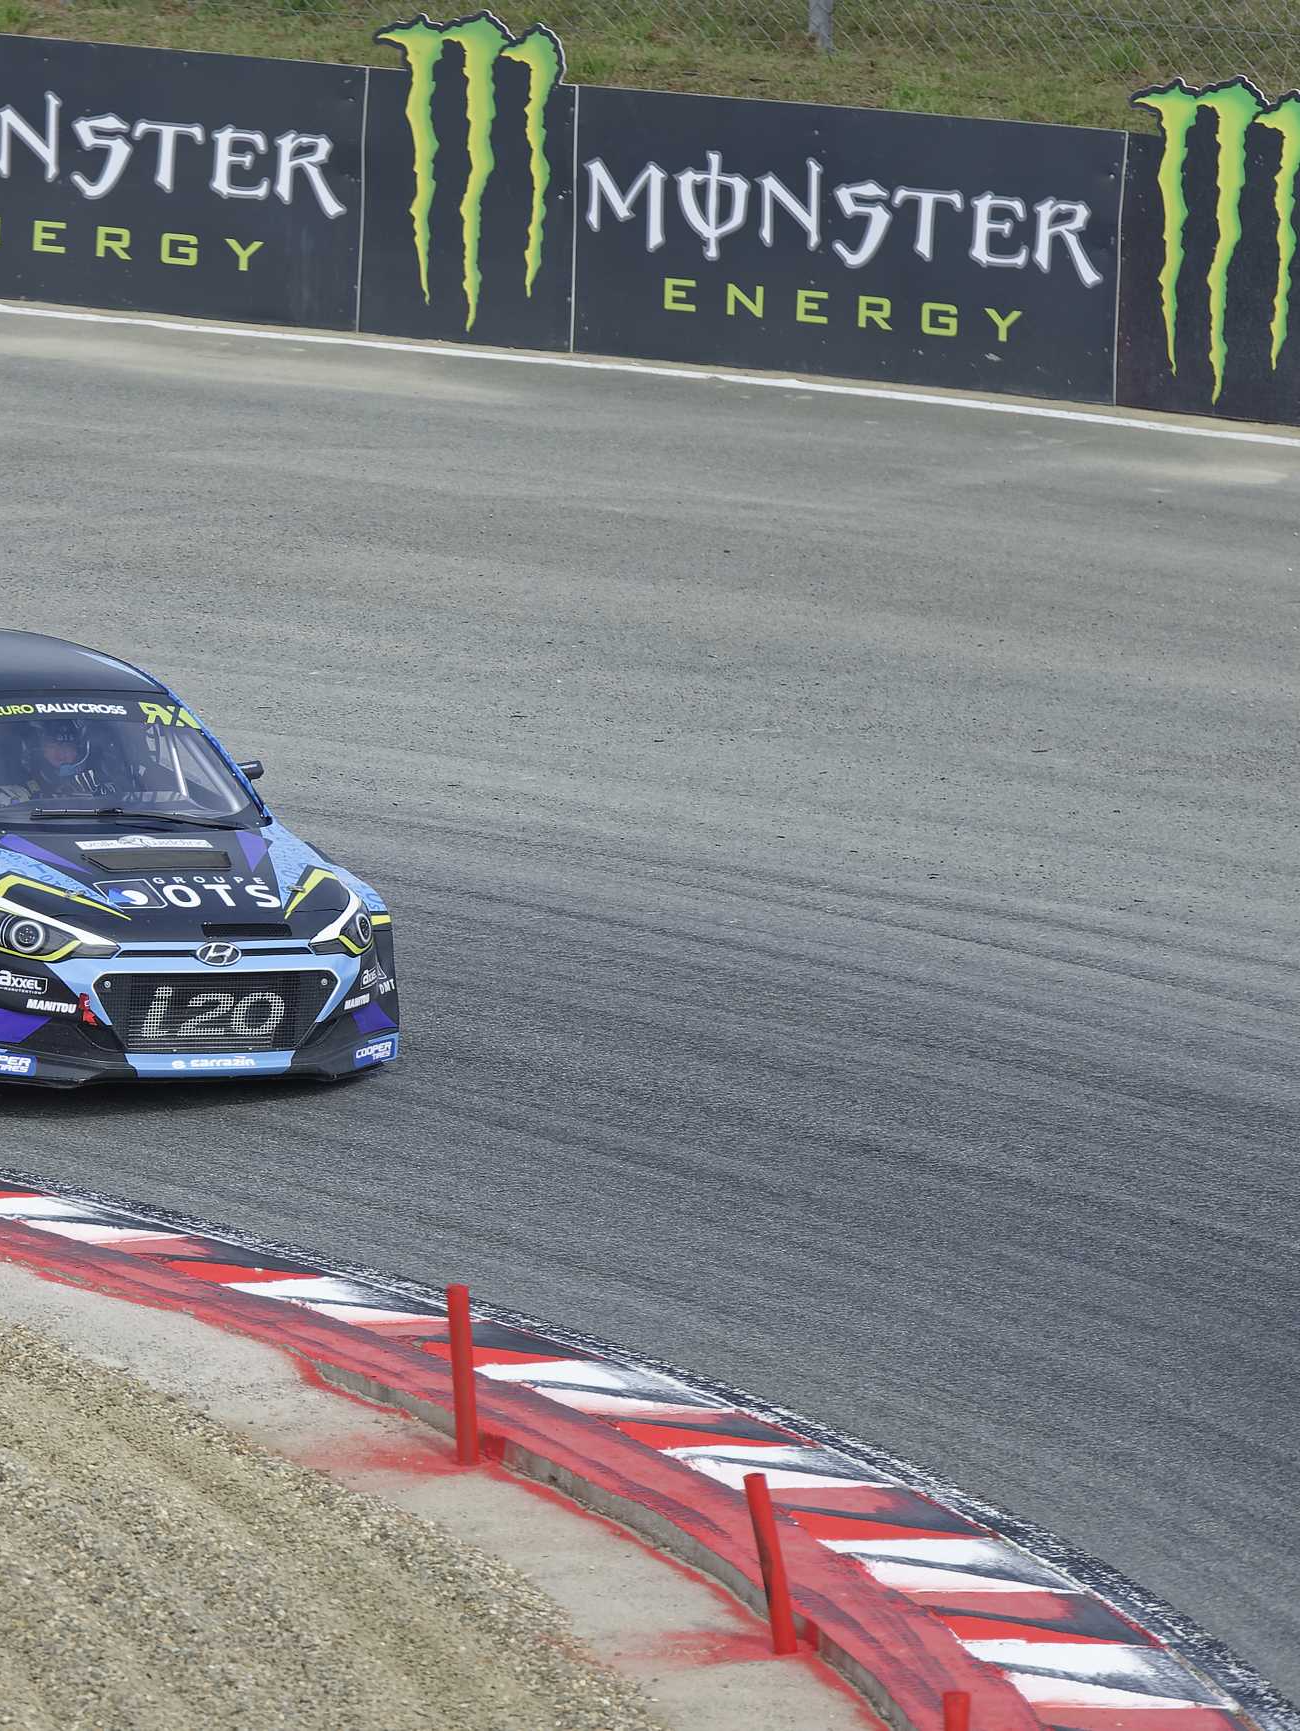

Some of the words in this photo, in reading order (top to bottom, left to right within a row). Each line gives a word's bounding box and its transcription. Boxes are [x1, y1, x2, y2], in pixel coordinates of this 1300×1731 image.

[584, 150, 1103, 288] MONSTER
[663, 277, 1023, 342] ENERGY
[35, 702, 127, 715] RALLYCROSS
[153, 876, 267, 885] GROUPE
[162, 884, 282, 908] OTS
[379, 978, 395, 995] OMT
[26, 999, 77, 1013] MANITOU
[355, 1041, 392, 1059] COOPER
